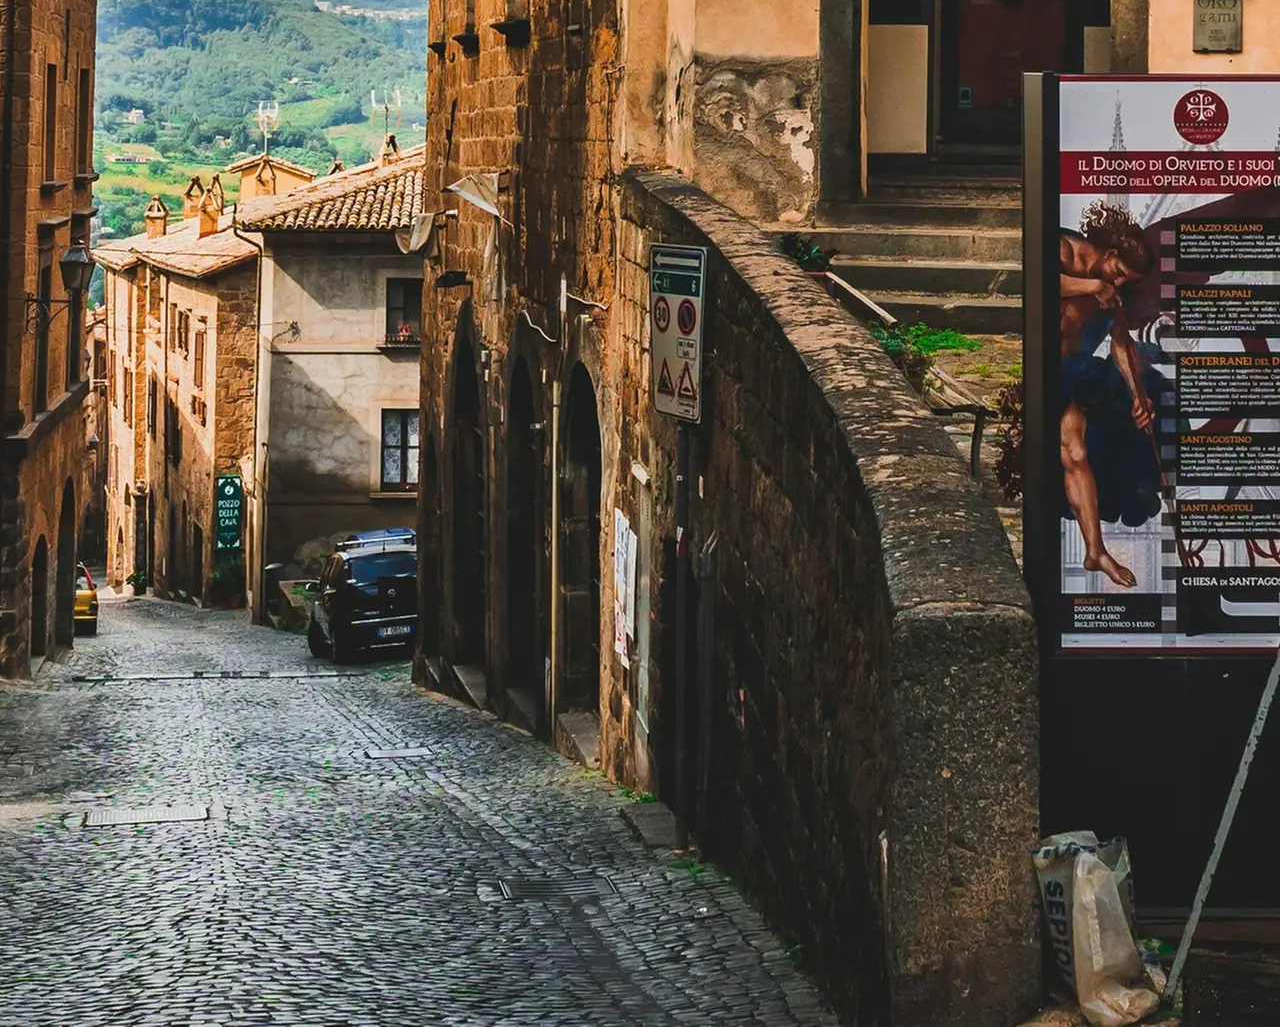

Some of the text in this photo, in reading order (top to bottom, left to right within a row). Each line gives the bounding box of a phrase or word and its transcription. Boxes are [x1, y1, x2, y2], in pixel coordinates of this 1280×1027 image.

[1081, 175, 1127, 187] MUSEO
[1200, 178, 1218, 187] DEL
[1220, 175, 1271, 187] DUOMO
[1180, 224, 1263, 232] PALAZZO SOLIANO
[1180, 290, 1251, 298] PALAZZI PAPALI
[656, 306, 666, 323] 30
[1180, 357, 1252, 366] SOTTERRANEI
[1180, 436, 1252, 444] SANT'AGOSTINO
[218, 500, 240, 508] POZZO
[1180, 504, 1253, 512] SANTI APOSTOLI
[219, 509, 239, 517] DELLA
[1182, 577, 1218, 586] CHIESA
